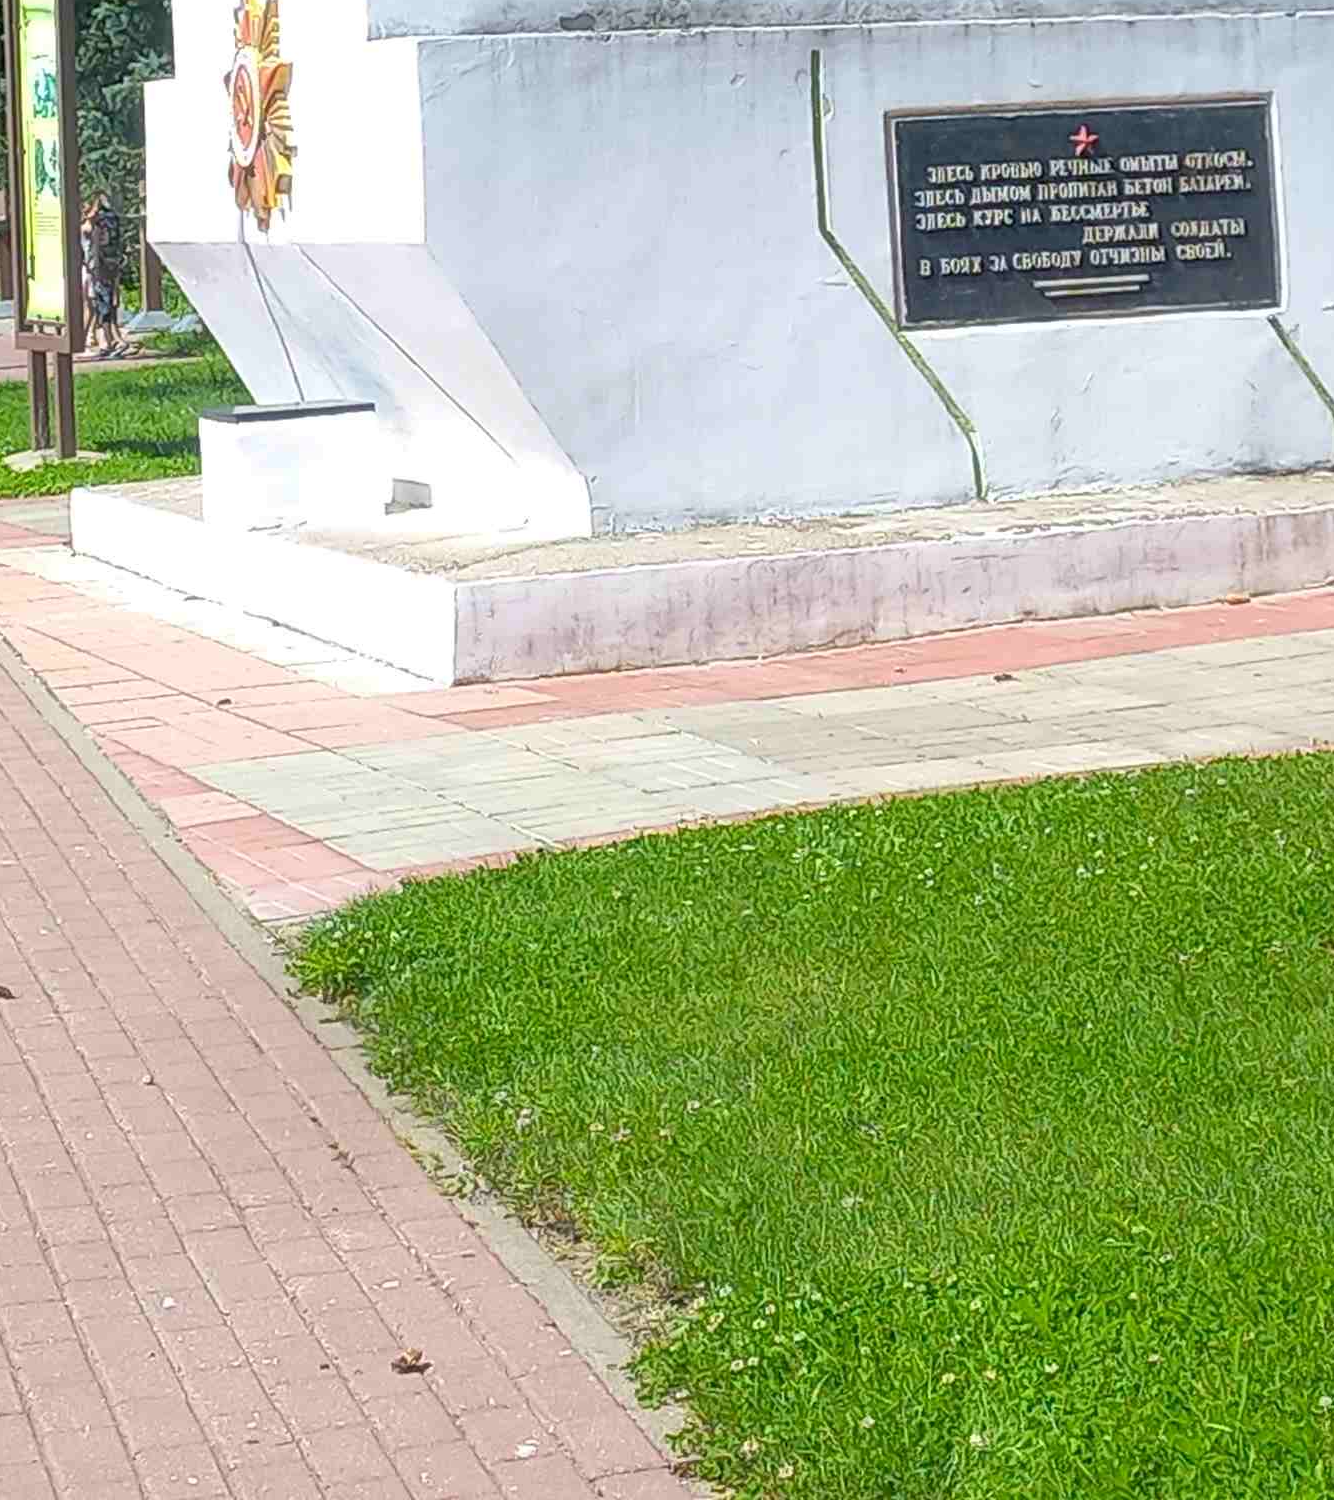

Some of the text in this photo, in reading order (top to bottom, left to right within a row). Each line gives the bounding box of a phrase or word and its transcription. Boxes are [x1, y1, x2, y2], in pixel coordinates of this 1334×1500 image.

[927, 164, 974, 183] ЗДЕСЬ
[980, 160, 1042, 181] КРОВЬЮ
[1049, 157, 1115, 177] РЕЧНЫЕ
[1119, 153, 1179, 172] ОМЫТЫ
[914, 188, 965, 207] ЗДЕСЬ
[970, 184, 1031, 205] ДЫМОМ
[1037, 179, 1118, 200] ПРОПИТАН
[1123, 176, 1173, 195] БЕТОН
[915, 201, 1150, 231] ЗДЕСЬ КУРС НА БЕССМЕРТЬЕ
[1082, 217, 1245, 245] ДЕРЖАЛИ СОЛДАТЫ
[919, 238, 1232, 277] В БОЯХ ЗА СВОБОДУ ОТЧИЗНЫ СВОЕЙ.
